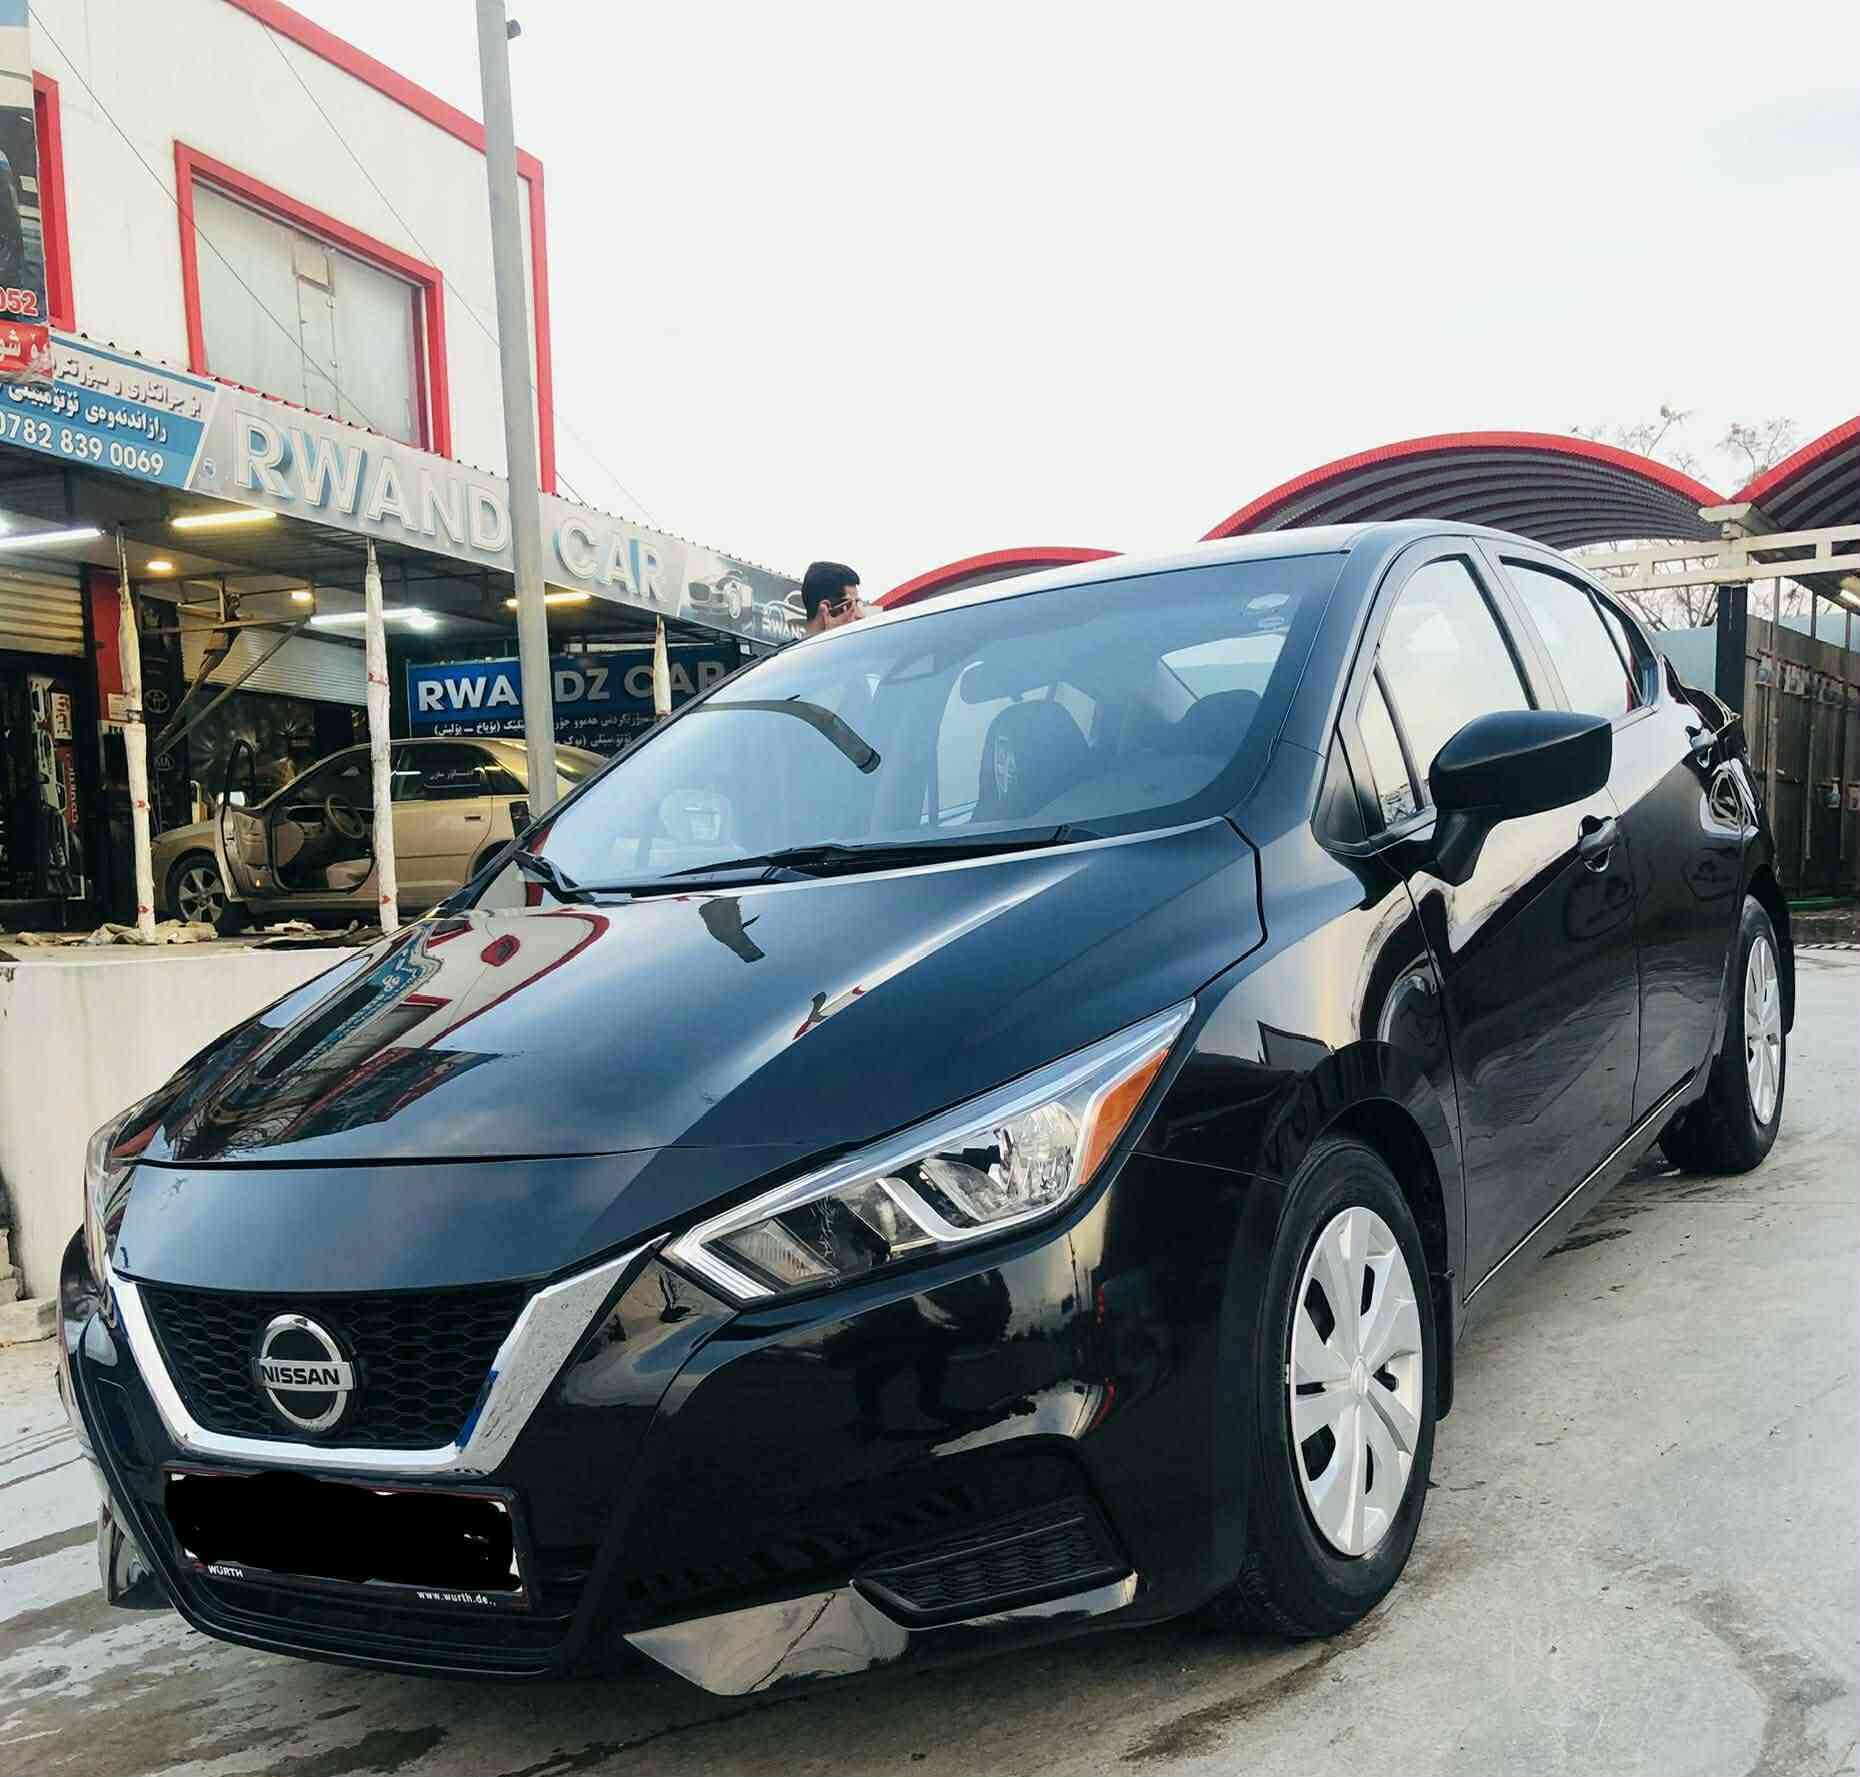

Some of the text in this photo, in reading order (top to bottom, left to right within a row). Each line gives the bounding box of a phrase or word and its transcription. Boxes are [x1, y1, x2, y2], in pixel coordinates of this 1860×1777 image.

[60, 428, 104, 459] 839
[109, 442, 165, 476] 0069
[233, 407, 667, 601] RWAND CAR
[417, 667, 611, 712] RWADZ
[261, 1365, 341, 1386] NISSAN
[207, 1564, 244, 1578] WÜRTH
